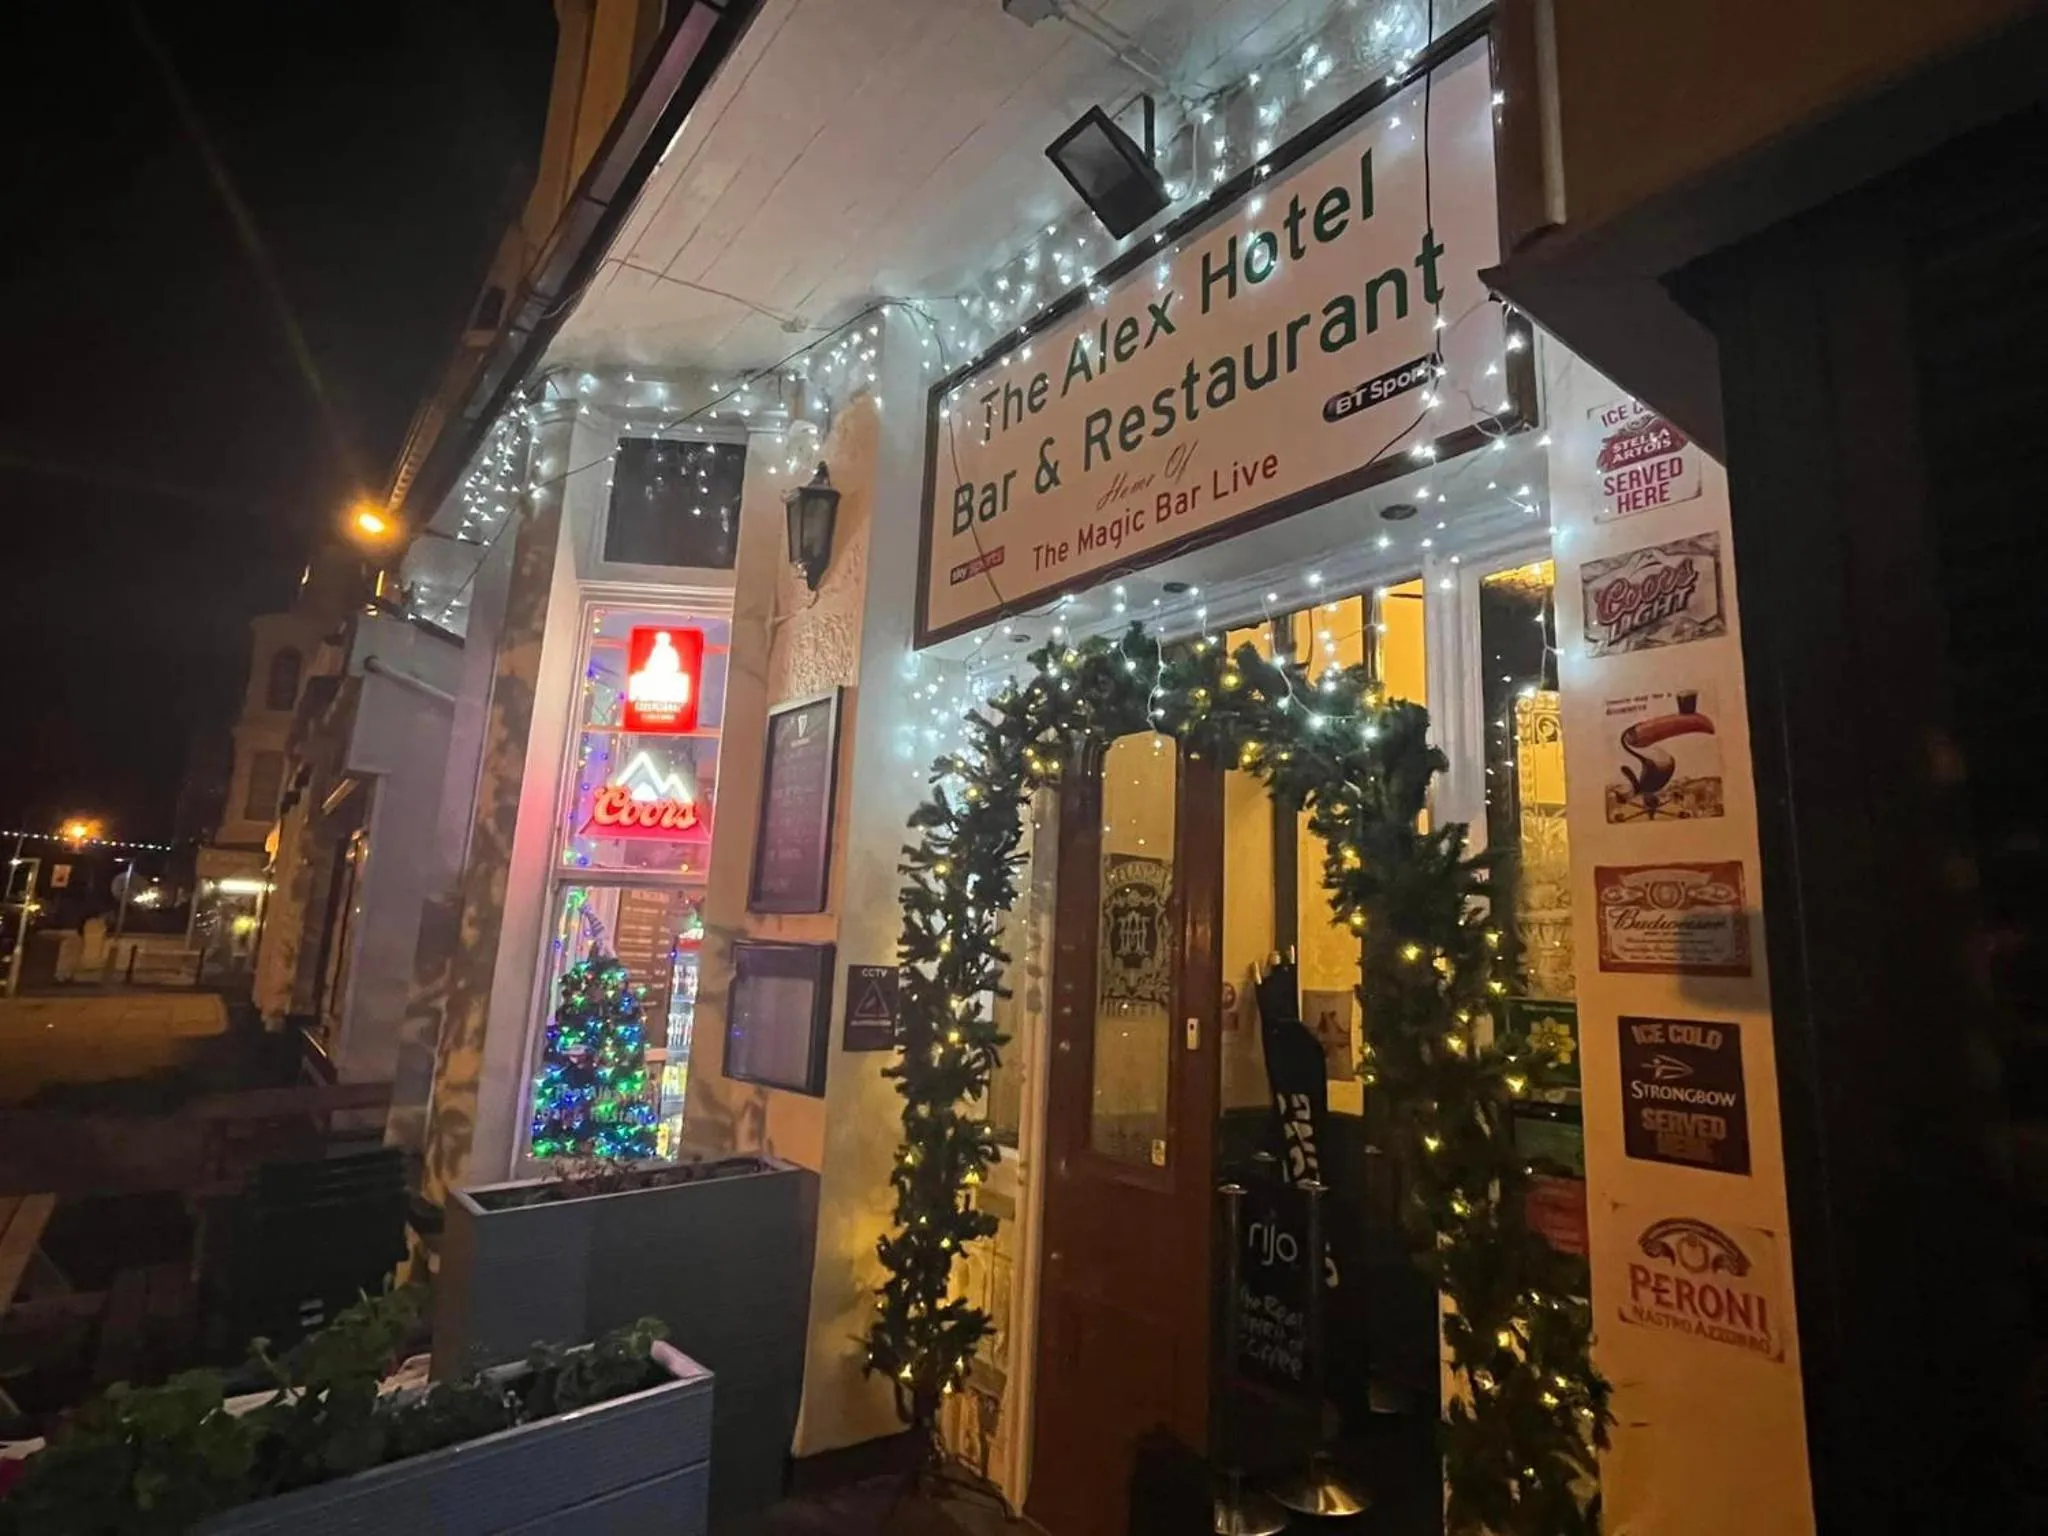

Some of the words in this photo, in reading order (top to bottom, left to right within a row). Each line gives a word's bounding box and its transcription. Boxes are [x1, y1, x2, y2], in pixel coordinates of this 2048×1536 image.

[980, 377, 1048, 440] The
[1061, 291, 1177, 397] Alex
[1201, 149, 1375, 312] Hotel
[953, 475, 1016, 537] Bar
[1035, 439, 1062, 494] &
[1083, 229, 1445, 471] Restaurant
[1336, 388, 1367, 414] BT
[1601, 404, 1628, 427] ICE
[1612, 428, 1670, 453] STELLA
[1612, 439, 1672, 464] ARTOIS
[1096, 472, 1156, 511] Home
[1164, 439, 1199, 484] Of
[1604, 457, 1683, 496] SERVED
[1032, 543, 1069, 572] The
[1077, 511, 1145, 556] Magic
[1155, 482, 1204, 524] Bar
[1212, 454, 1279, 499] Live
[1617, 482, 1671, 514] HERE
[1596, 560, 1698, 624] Coors
[1608, 588, 1694, 642] LIGHT
[592, 786, 700, 830] Coors
[861, 968, 888, 979] CCTV
[1631, 1024, 1666, 1045] ICE
[1668, 1024, 1723, 1050] COLD
[1641, 1107, 1727, 1140] SERVED
[1628, 1262, 1771, 1336] PERONI
